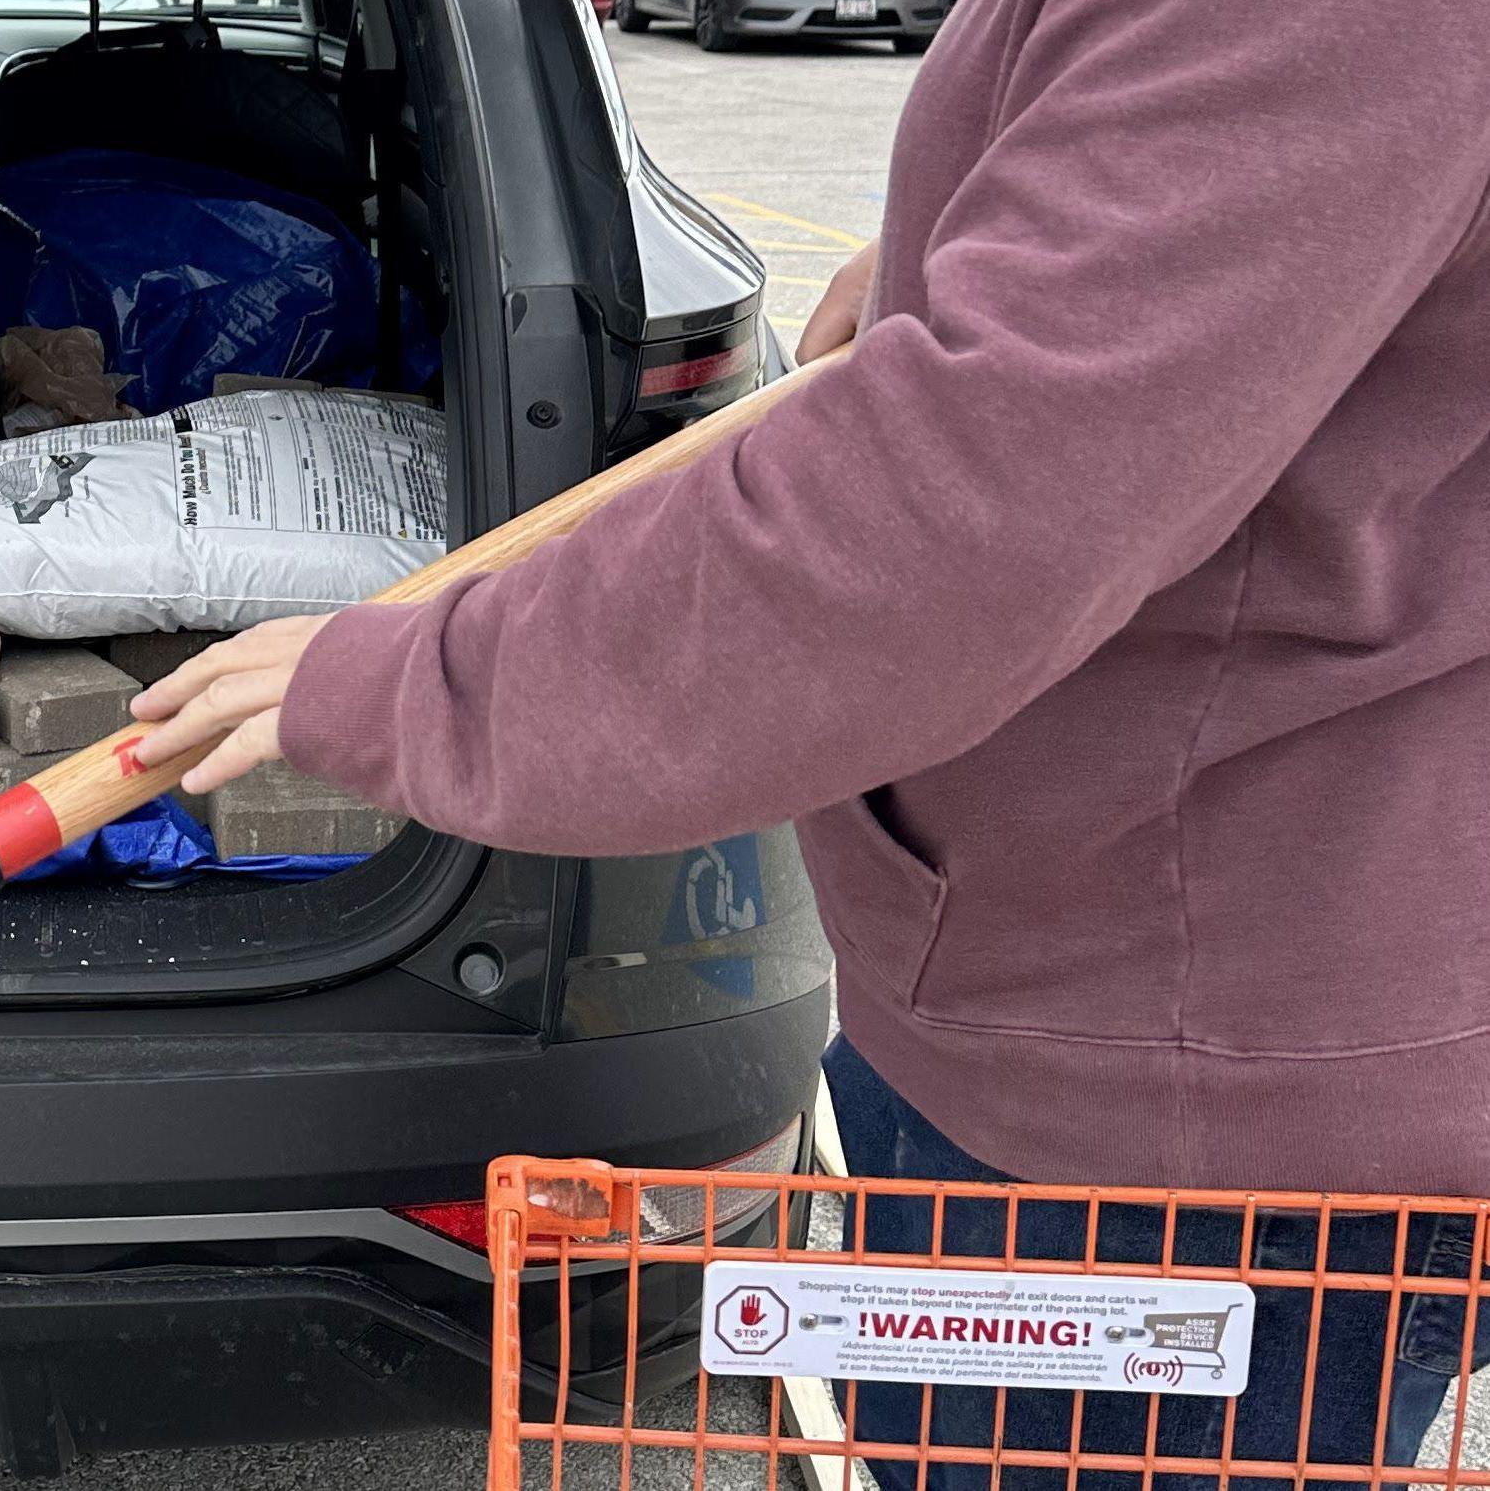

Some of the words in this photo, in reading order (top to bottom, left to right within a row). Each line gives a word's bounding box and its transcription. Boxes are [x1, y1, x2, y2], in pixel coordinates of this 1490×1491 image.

[180, 449, 193, 462] You
[181, 463, 194, 474] Do
[182, 475, 197, 499] Much
[184, 501, 197, 526] How
[798, 1280, 850, 1293] Shopping
[854, 1283, 883, 1293] Carts
[886, 1285, 908, 1296] may
[911, 1287, 936, 1297] stop
[938, 1289, 1011, 1301] unexpectedly
[1014, 1292, 1025, 1300] at
[1027, 1292, 1048, 1301] exit
[1050, 1293, 1082, 1302] doors
[1085, 1294, 1106, 1303] and
[1108, 1296, 1136, 1304] carts
[1138, 1296, 1158, 1305] will
[840, 1295, 865, 1305] stop
[867, 1295, 876, 1304] if
[878, 1297, 909, 1306] taken
[911, 1298, 952, 1308] beyond
[955, 1300, 973, 1309] the
[975, 1302, 1028, 1311] perimeter
[1031, 1303, 1043, 1312] of
[1046, 1304, 1064, 1313] the
[1066, 1305, 1107, 1316] parking
[1110, 1307, 1128, 1316] lot.
[1155, 1323, 1216, 1333] PROTECTION
[1185, 1318, 1216, 1326] ASSET
[734, 1328, 769, 1338] STOP
[858, 1311, 1092, 1347] !WARNING!
[1180, 1332, 1214, 1341] DEVICE
[1163, 1338, 1215, 1349] INSTALLED
